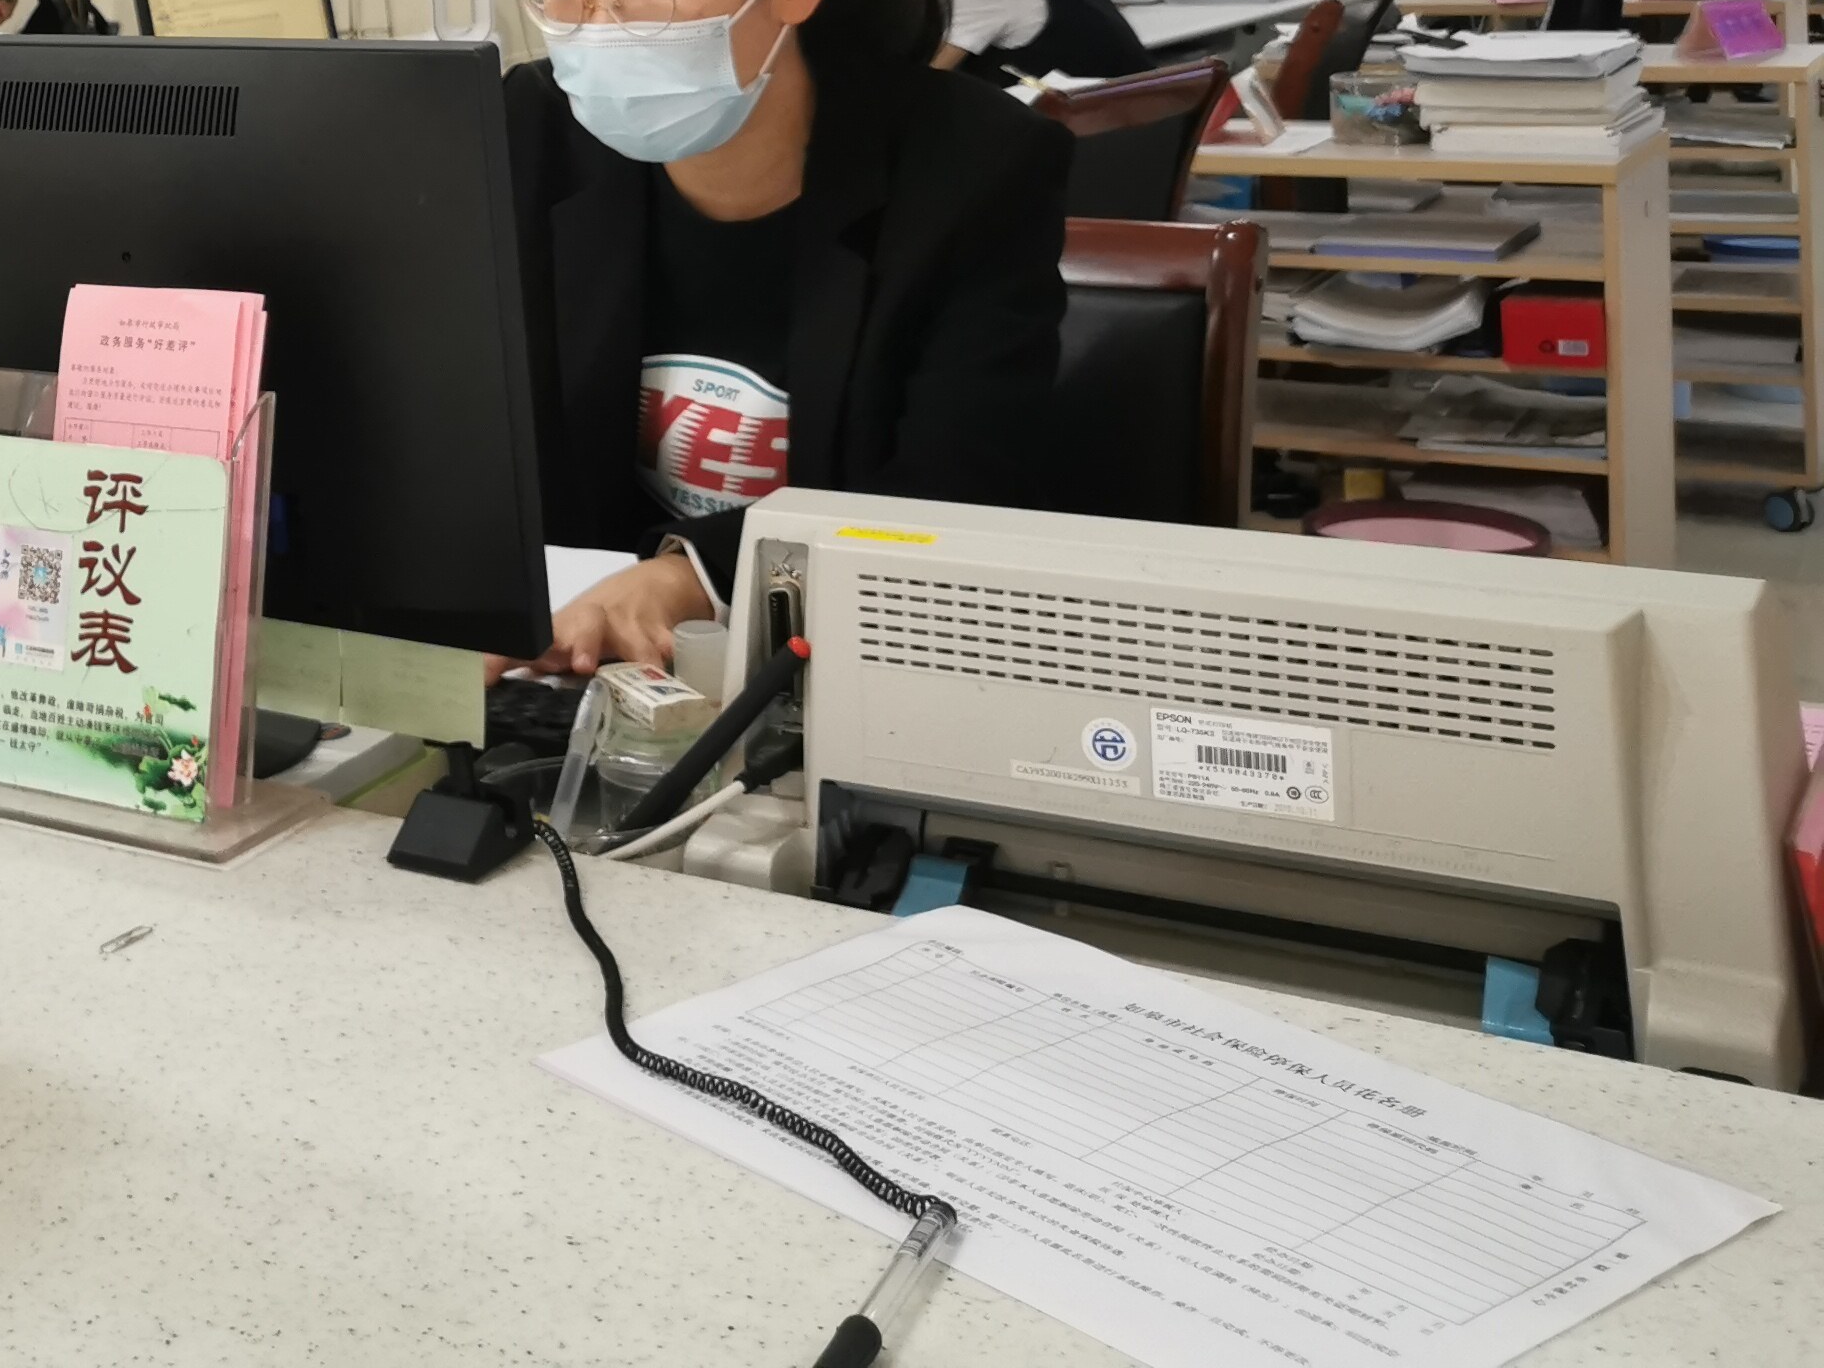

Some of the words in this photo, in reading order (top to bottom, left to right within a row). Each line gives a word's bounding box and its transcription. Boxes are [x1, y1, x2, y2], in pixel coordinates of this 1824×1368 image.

[692, 378, 741, 403] SPORT
[70, 466, 150, 677] 评议表
[1156, 711, 1191, 724] EPSON
[1117, 1001, 1431, 1119] 如皋市社会保险停保人员花名册
